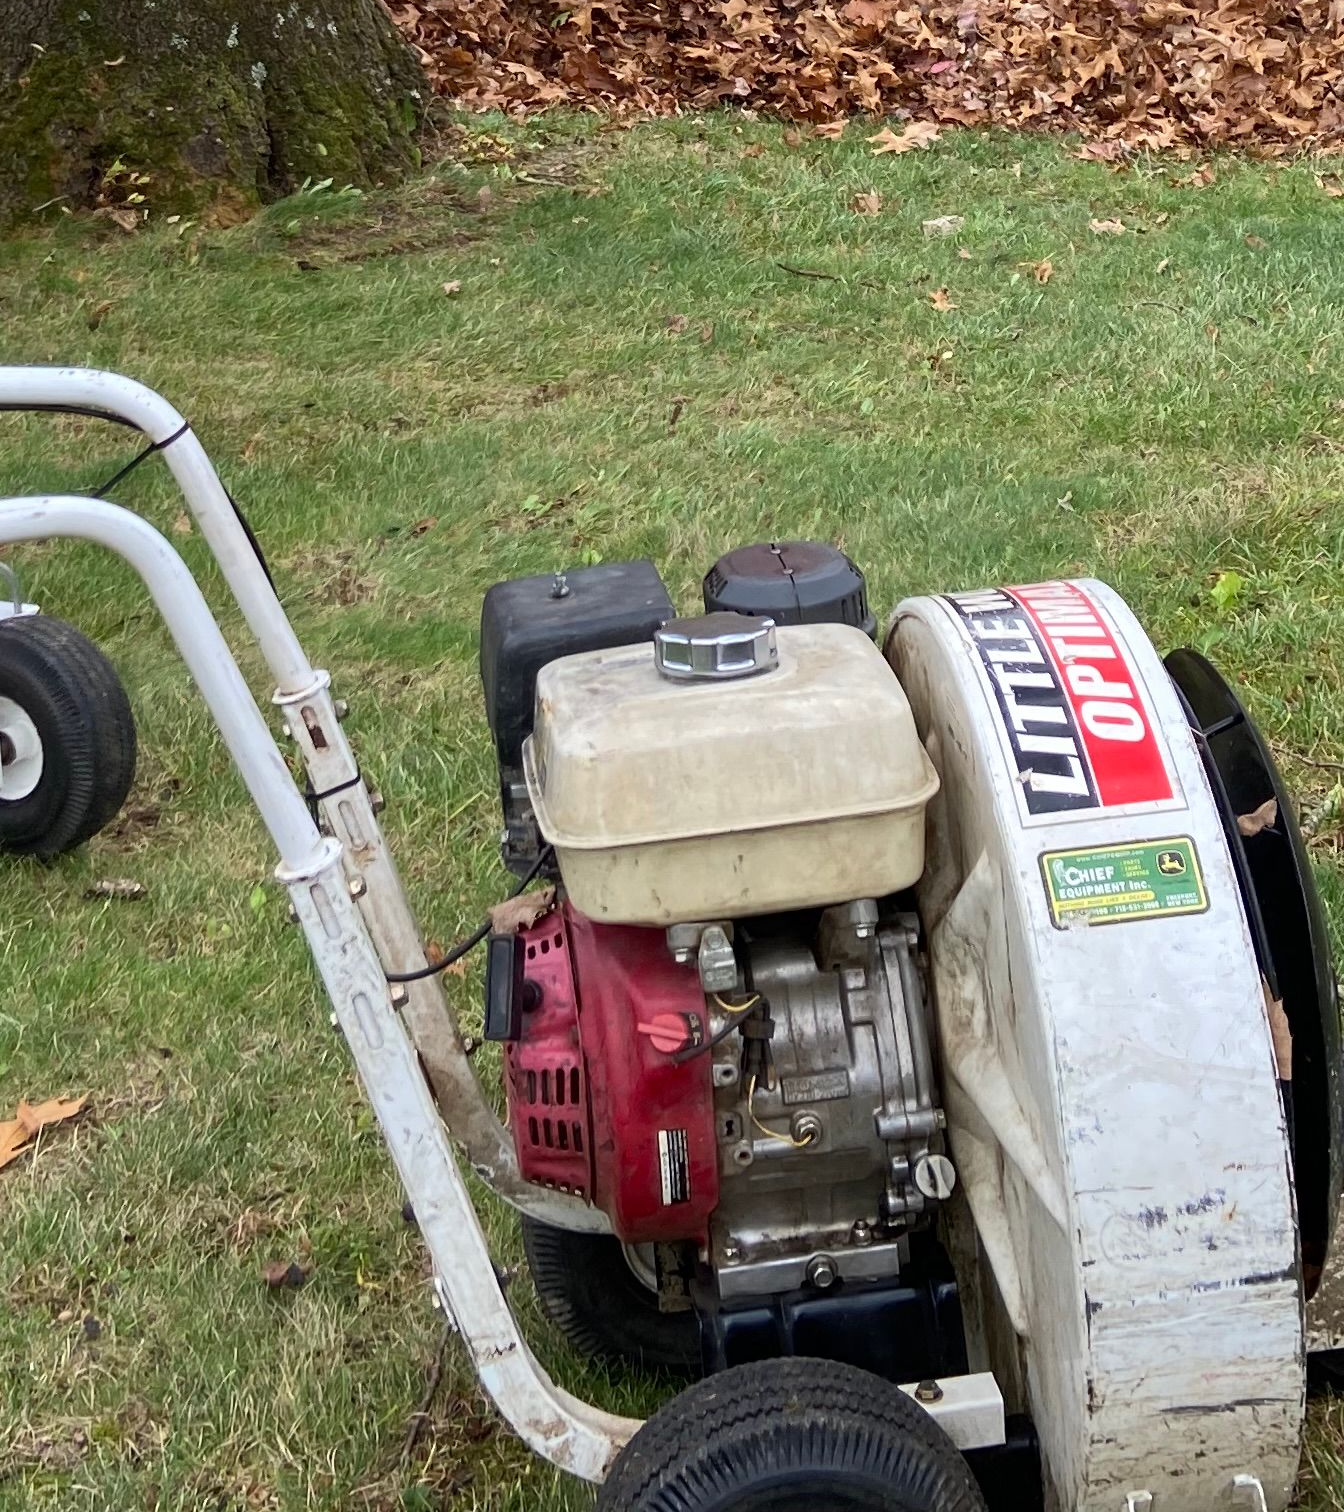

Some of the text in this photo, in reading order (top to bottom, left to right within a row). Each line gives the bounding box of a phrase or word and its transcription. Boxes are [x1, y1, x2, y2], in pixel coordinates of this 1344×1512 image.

[971, 618, 1090, 796] LITTLE
[1064, 865, 1114, 886] CHIEF
[1058, 881, 1125, 899] EQUIPMENT
